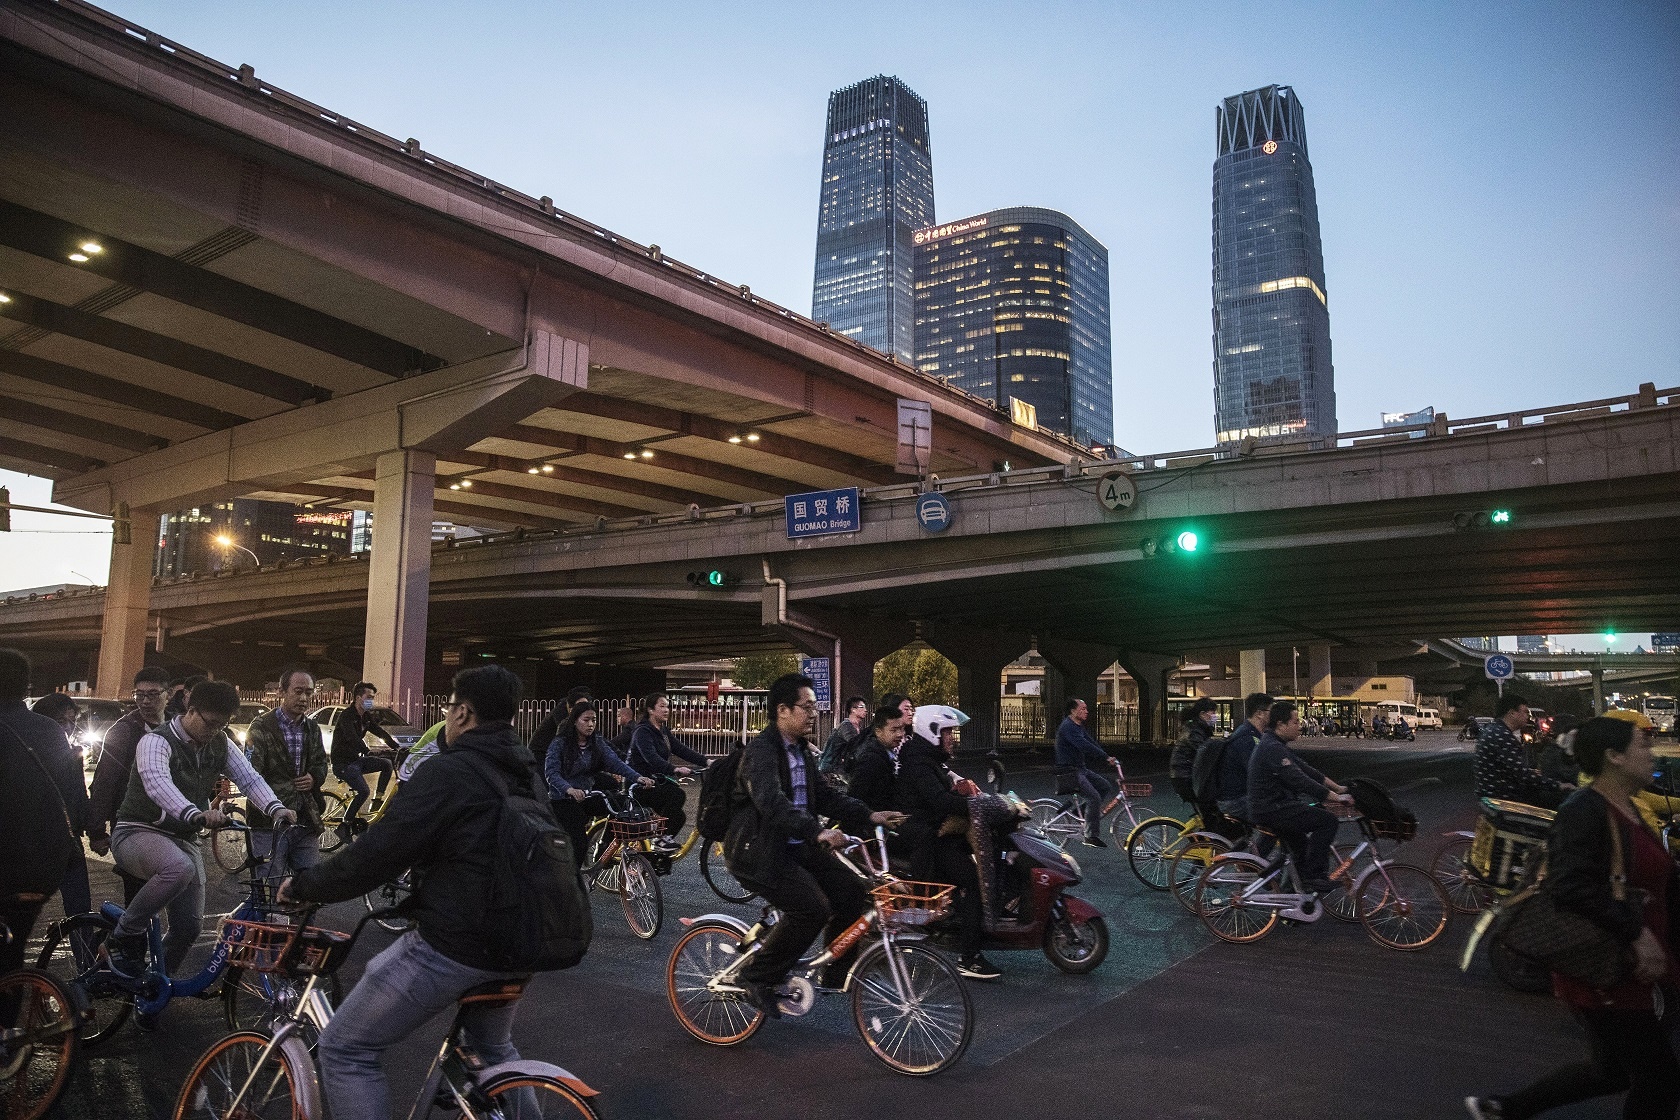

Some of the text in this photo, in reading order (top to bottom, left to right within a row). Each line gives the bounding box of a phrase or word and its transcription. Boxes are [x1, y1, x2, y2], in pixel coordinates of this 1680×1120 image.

[952, 223, 969, 232] China
[969, 218, 987, 228] World
[1384, 413, 1404, 423] FFC
[1105, 484, 1130, 501] 4m
[794, 496, 850, 519] 国贸桥
[794, 519, 851, 531] GUOMAO Bridge
